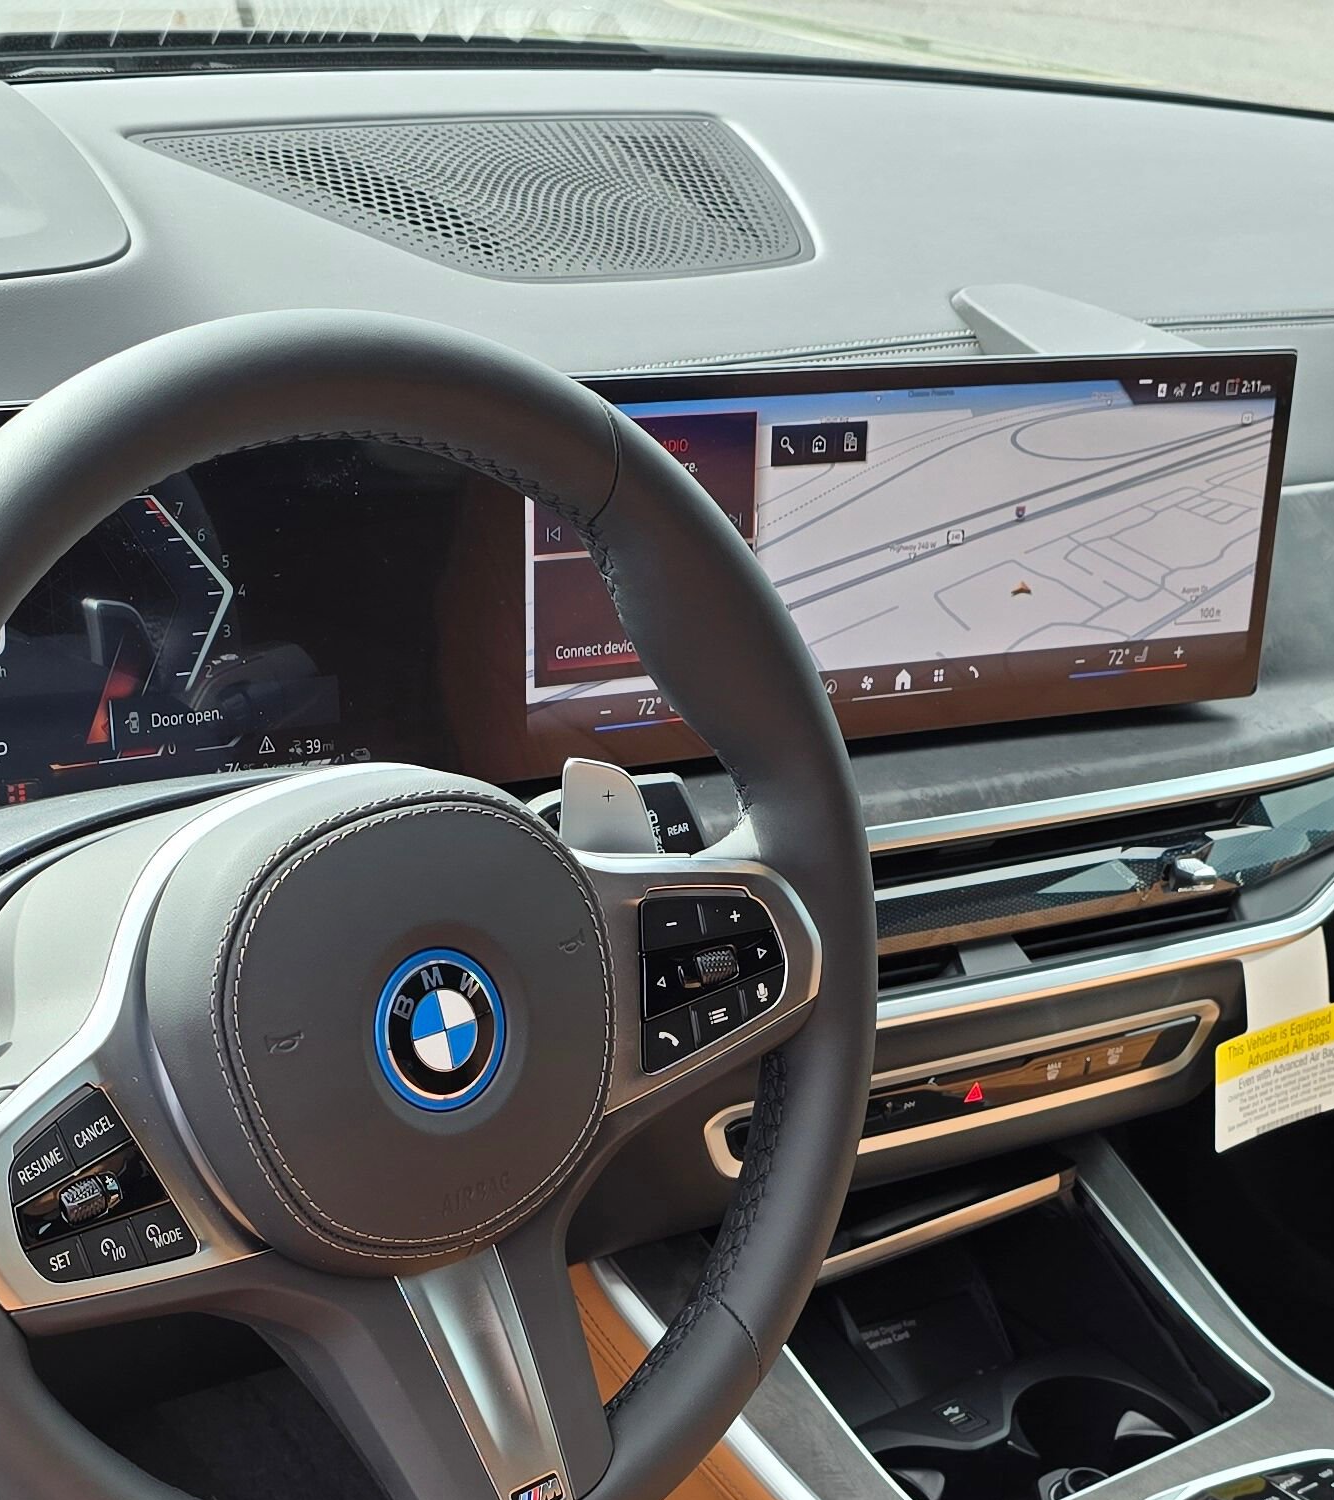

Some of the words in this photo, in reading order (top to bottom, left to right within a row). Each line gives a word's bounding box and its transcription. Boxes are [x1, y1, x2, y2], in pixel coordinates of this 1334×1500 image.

[175, 502, 184, 515] 7
[197, 528, 206, 542] 6
[221, 554, 231, 569] 5
[237, 583, 247, 598] 4
[1200, 607, 1214, 618] 100
[222, 624, 232, 638] 3
[556, 643, 602, 660] Connect
[604, 639, 636, 655] devic
[205, 665, 214, 679] 2
[151, 712, 183, 729] Door
[186, 709, 224, 726] open.
[306, 739, 321, 755] 39
[322, 740, 334, 752] mi
[667, 822, 689, 837] REAR
[393, 966, 479, 1021] BMW
[1228, 1043, 1244, 1060] This
[1246, 1030, 1278, 1050] Vehicle
[1280, 1027, 1287, 1039] is
[1290, 1012, 1332, 1036] Equipped
[1247, 1046, 1290, 1068] Advanced
[1293, 1038, 1305, 1051] Air
[1308, 1030, 1330, 1047] Bags
[1239, 1076, 1255, 1090] Even
[1256, 1068, 1271, 1082] with
[1273, 1057, 1308, 1075] Advanced
[1310, 1051, 1321, 1063] Air
[17, 1147, 64, 1186] RESUME
[73, 1115, 115, 1149] CANCEL
[154, 1227, 183, 1249] MODE
[49, 1251, 72, 1272] SET
